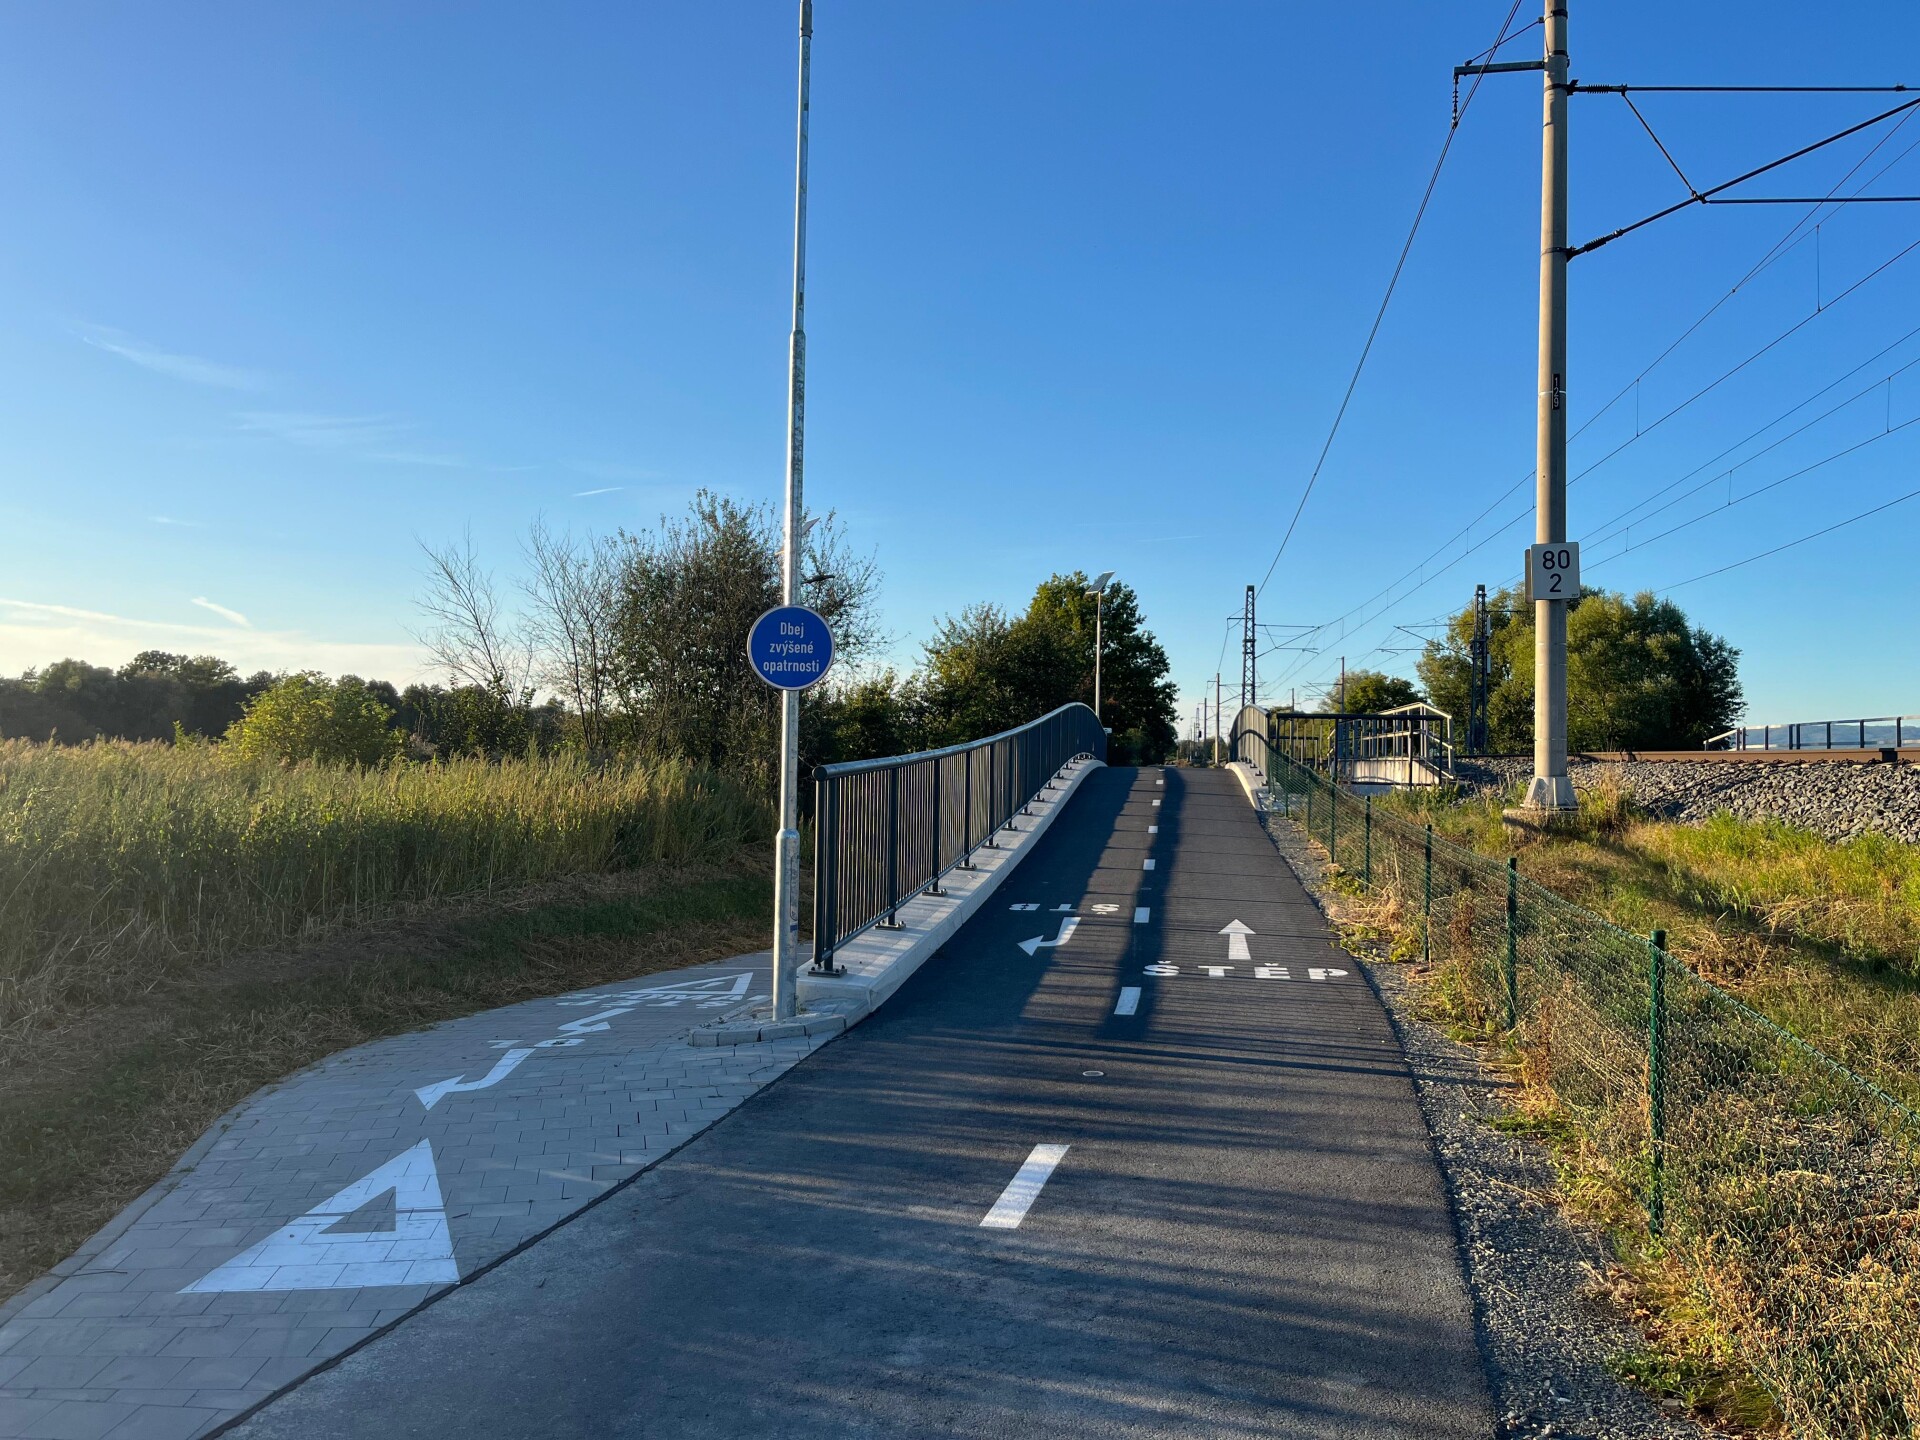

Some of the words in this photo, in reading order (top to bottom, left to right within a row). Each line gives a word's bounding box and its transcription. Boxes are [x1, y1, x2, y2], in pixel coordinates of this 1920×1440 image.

[1542, 549, 1571, 570] 80
[1549, 573, 1562, 593] 2
[780, 622, 804, 639] Dbej
[769, 640, 814, 656] zvýšené
[763, 659, 819, 675] opatrnosti
[1142, 960, 1349, 980] ŠTĚP
